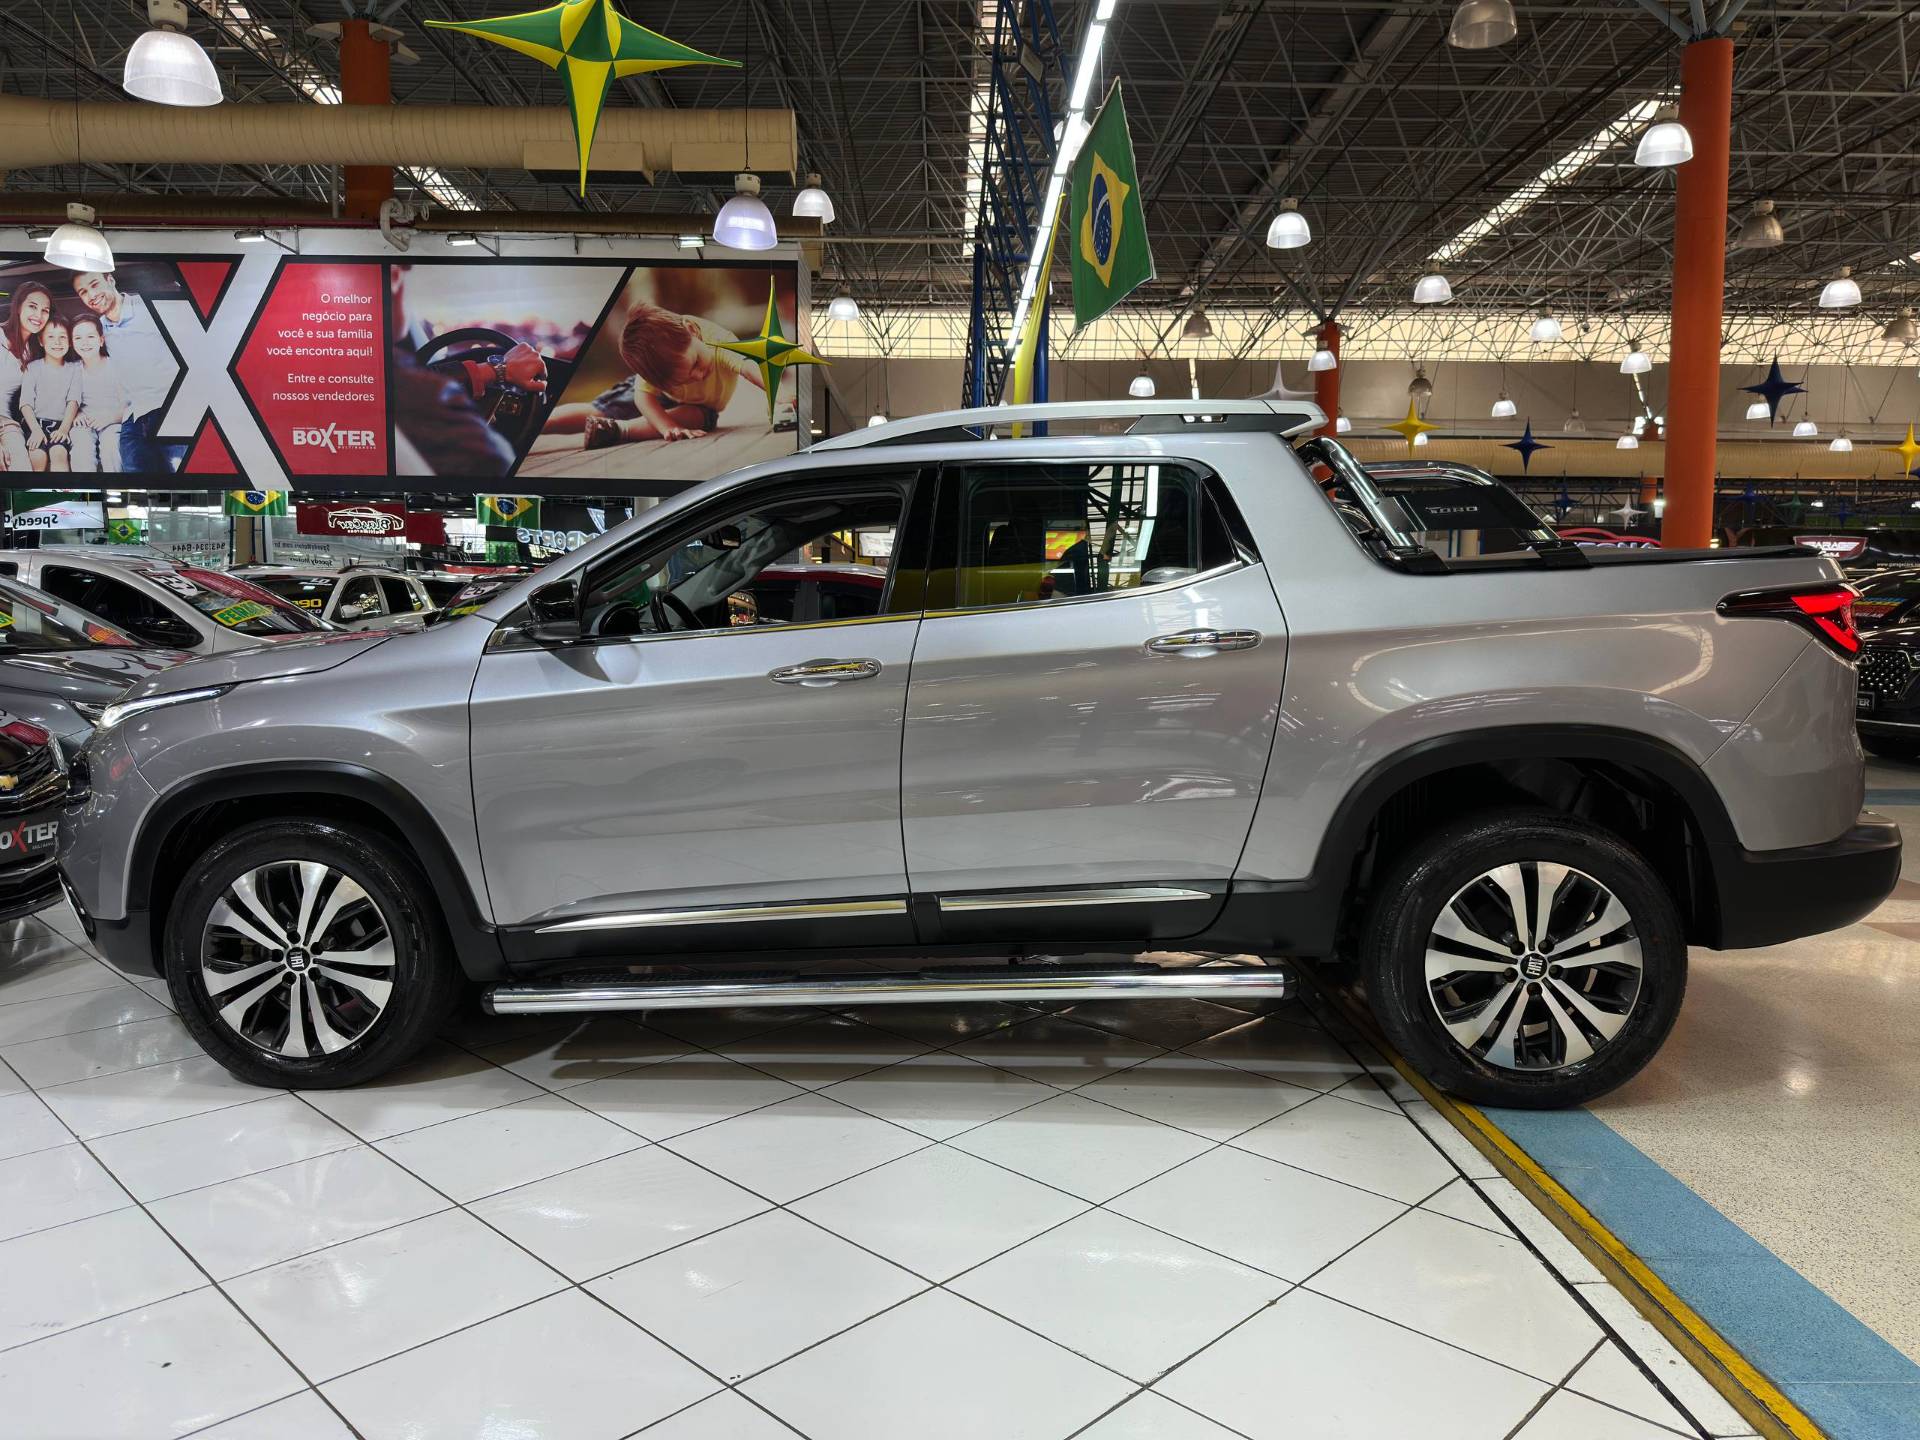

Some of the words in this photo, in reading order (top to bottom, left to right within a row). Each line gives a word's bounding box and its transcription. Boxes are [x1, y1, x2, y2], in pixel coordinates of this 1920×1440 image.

[320, 293, 331, 304] O
[333, 293, 372, 304] melhor
[302, 311, 346, 324] negócio
[349, 313, 373, 324] para
[278, 328, 304, 339] você
[306, 330, 314, 339] e
[316, 330, 335, 339] sua
[337, 328, 373, 339] família
[266, 345, 293, 356] você
[295, 346, 344, 356] encontra
[346, 346, 373, 359] aqui!
[287, 373, 316, 384] Entre
[318, 375, 326, 384] e
[328, 373, 374, 384] consulte
[272, 391, 310, 401] nossos
[312, 391, 375, 402] vendedores
[292, 422, 376, 454] BOXTER
[0, 820, 60, 853] OXTER
[1526, 956, 1544, 976] FIAT
